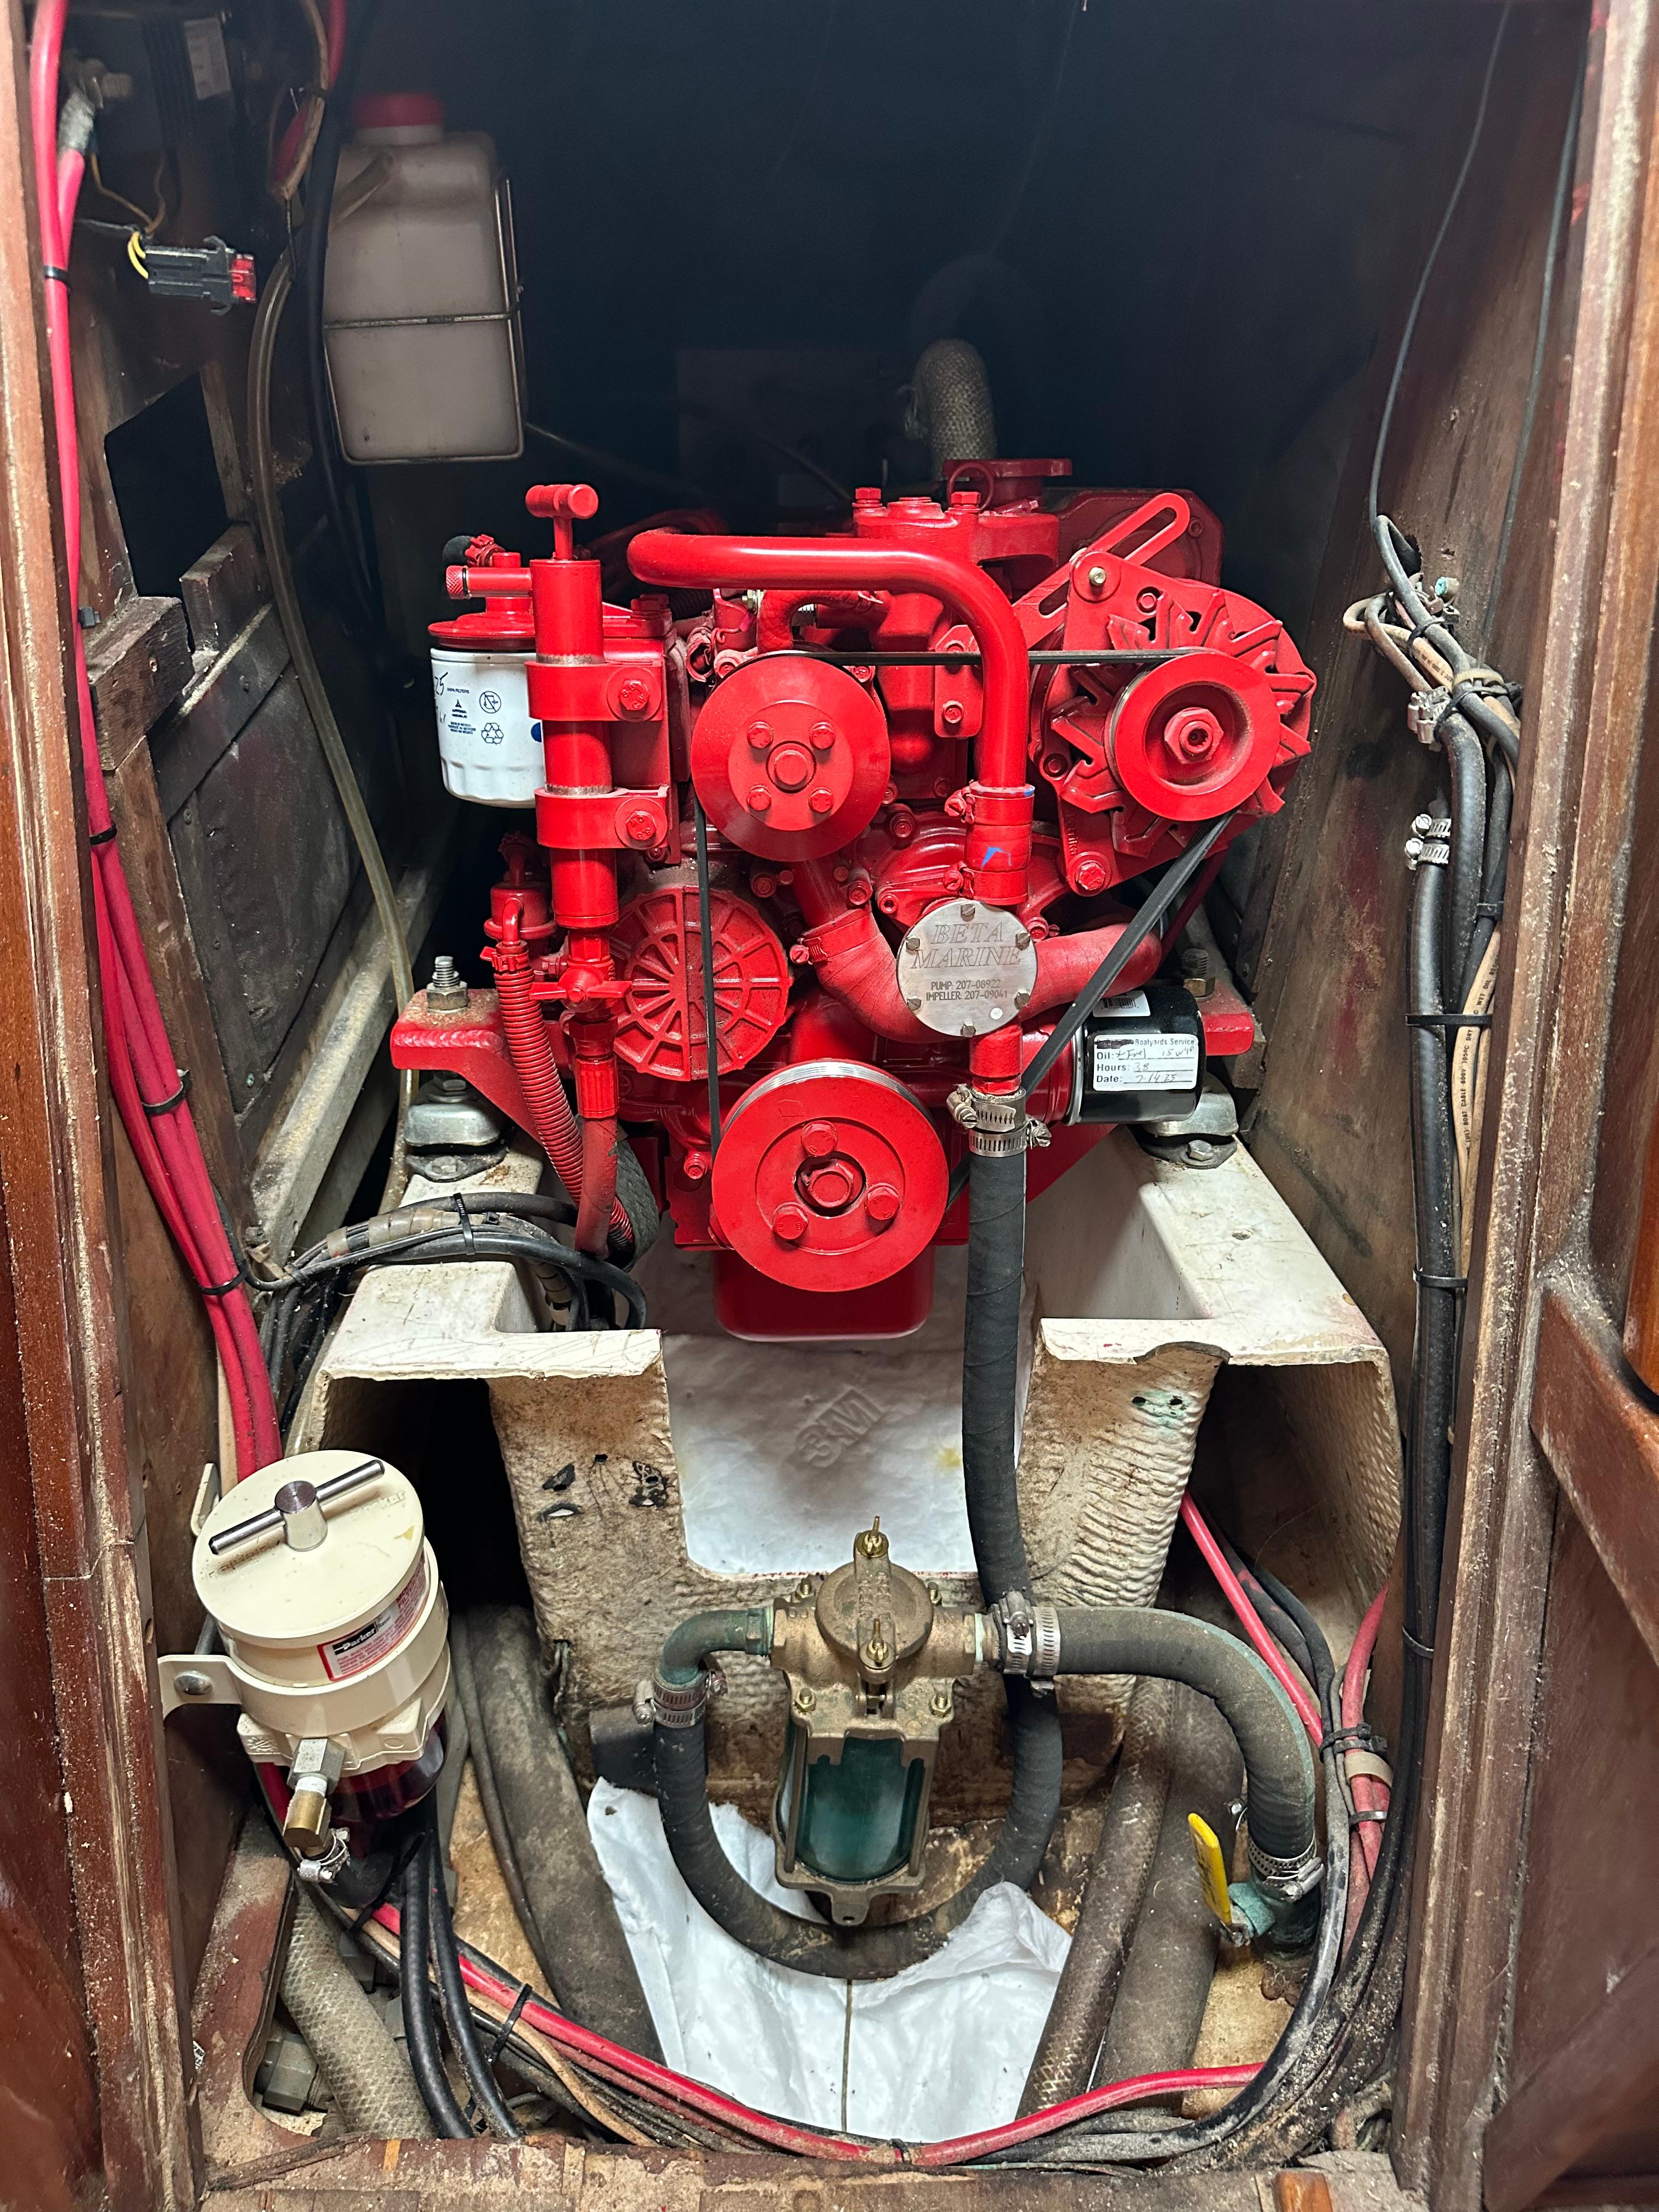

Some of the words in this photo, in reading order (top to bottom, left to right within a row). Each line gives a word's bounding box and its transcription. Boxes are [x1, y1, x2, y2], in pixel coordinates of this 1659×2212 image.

[930, 922, 1003, 944] BETA
[911, 946, 1023, 969] MARINE
[926, 991, 962, 1001] IMPELLER:
[965, 990, 1007, 1000] 207-09041
[931, 981, 953, 990] PUMP:
[956, 979, 1001, 990] 207-08922
[1476, 994, 1485, 1006] WET
[1483, 980, 1491, 989] OIL
[792, 1386, 885, 1468] 3M
[343, 1628, 375, 1650] Parker
